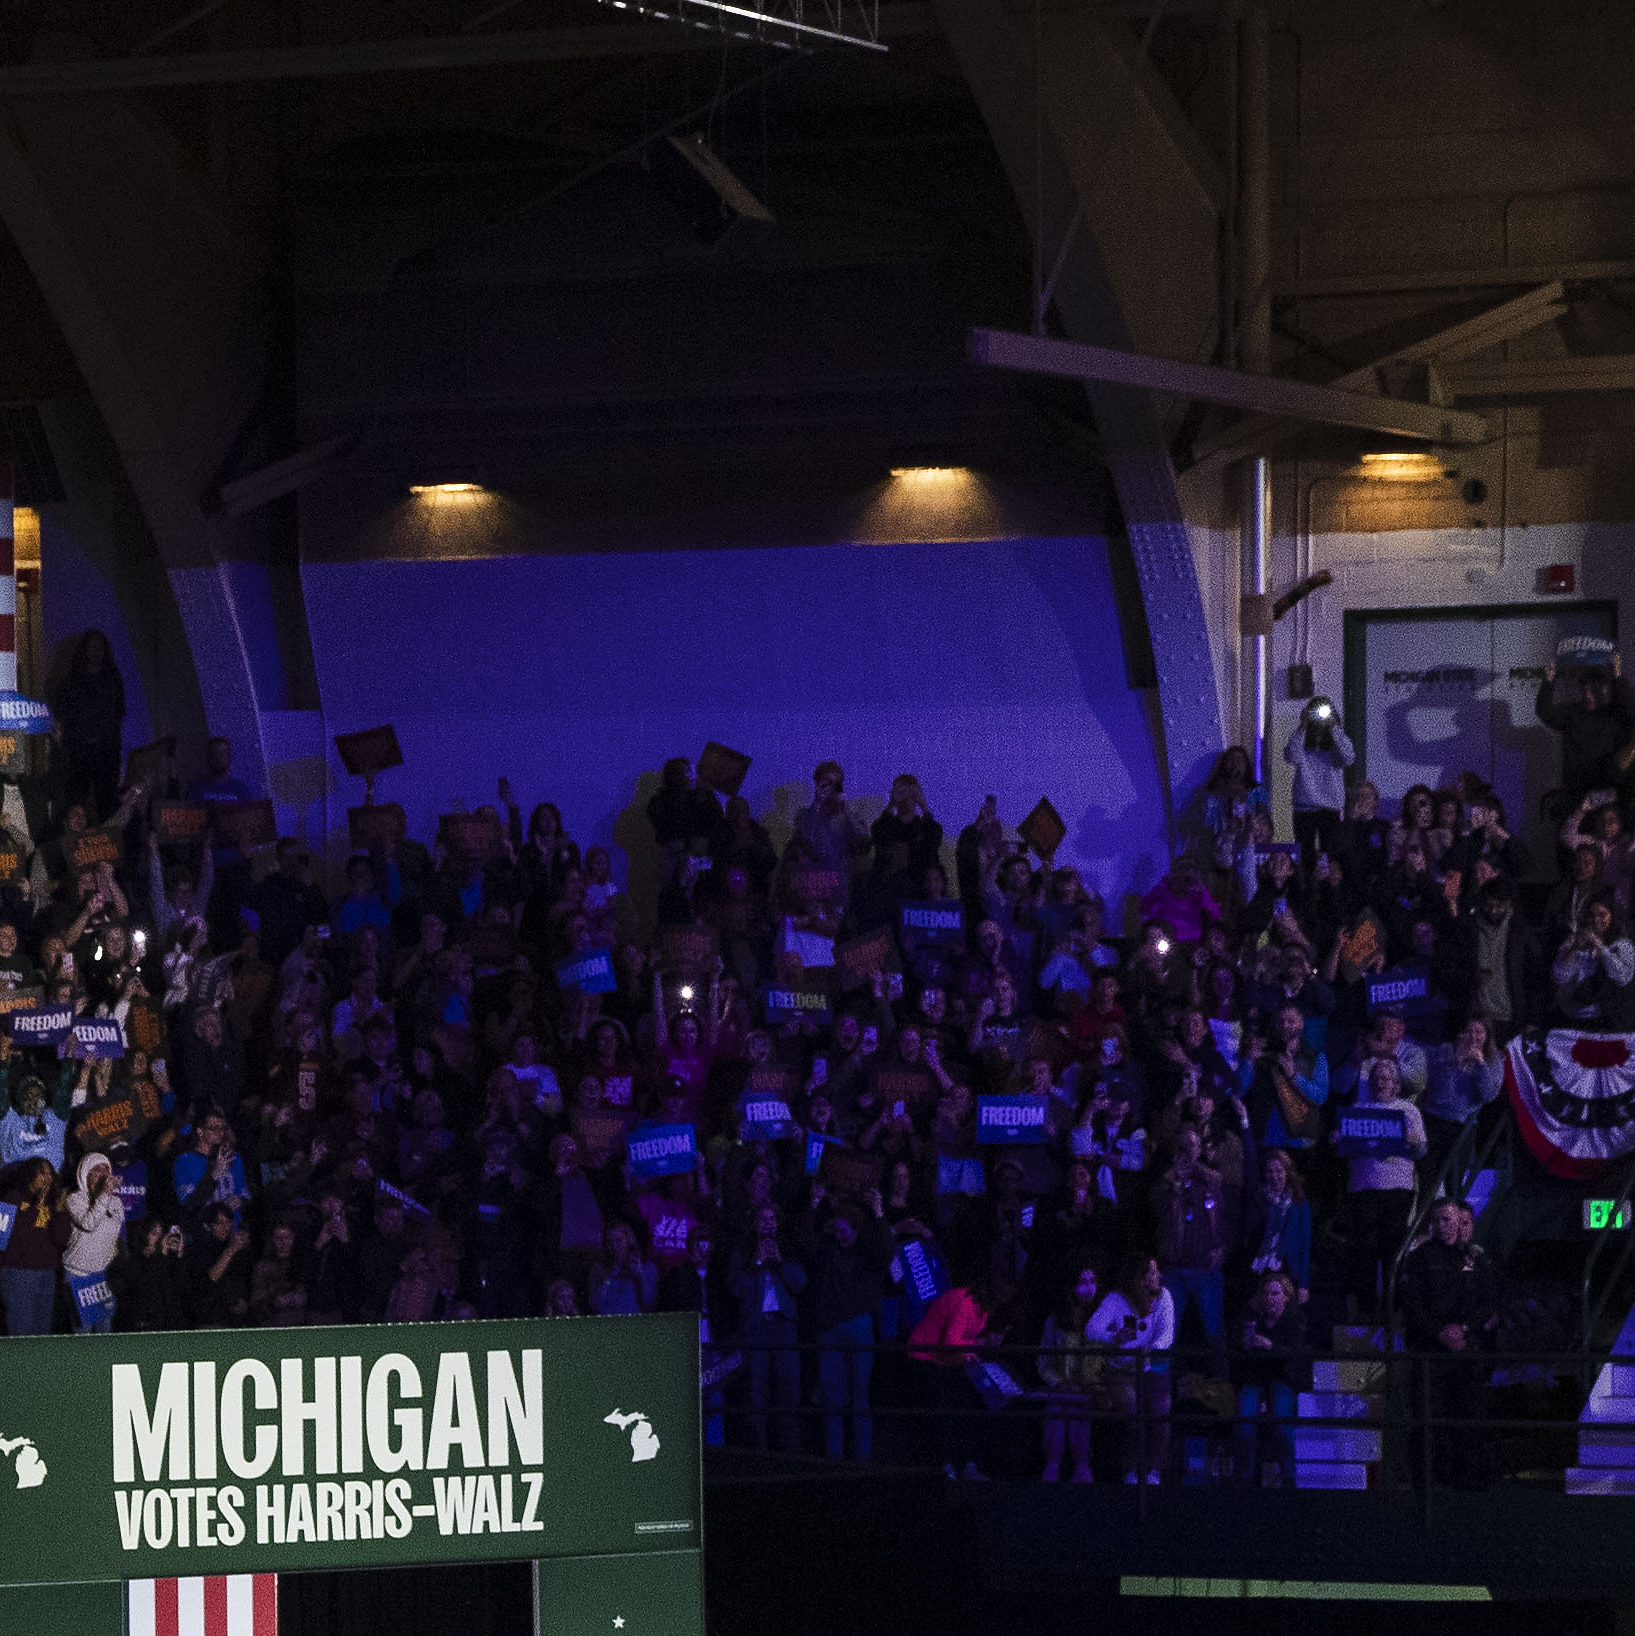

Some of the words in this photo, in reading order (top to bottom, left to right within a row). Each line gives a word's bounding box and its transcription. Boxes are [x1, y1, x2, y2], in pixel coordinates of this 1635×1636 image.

[904, 908, 962, 930] FREEDOM
[768, 991, 827, 1010] FREEDOM
[1370, 978, 1427, 1003] FREEDOM
[13, 1011, 73, 1033] FREEDOM
[74, 1023, 118, 1043] EEDOM
[298, 1071, 317, 1110] 5
[980, 1105, 1044, 1127] FREEDOM
[1340, 1118, 1402, 1138] FREEDOM
[629, 1134, 692, 1162] FREEDOM
[111, 1184, 146, 1197] ARRIS
[903, 1241, 938, 1300] FREEDOM
[112, 1349, 544, 1482] MICHIGAN
[115, 1485, 245, 1549] VOTES
[257, 1472, 544, 1543] HARRIS-WALZ
